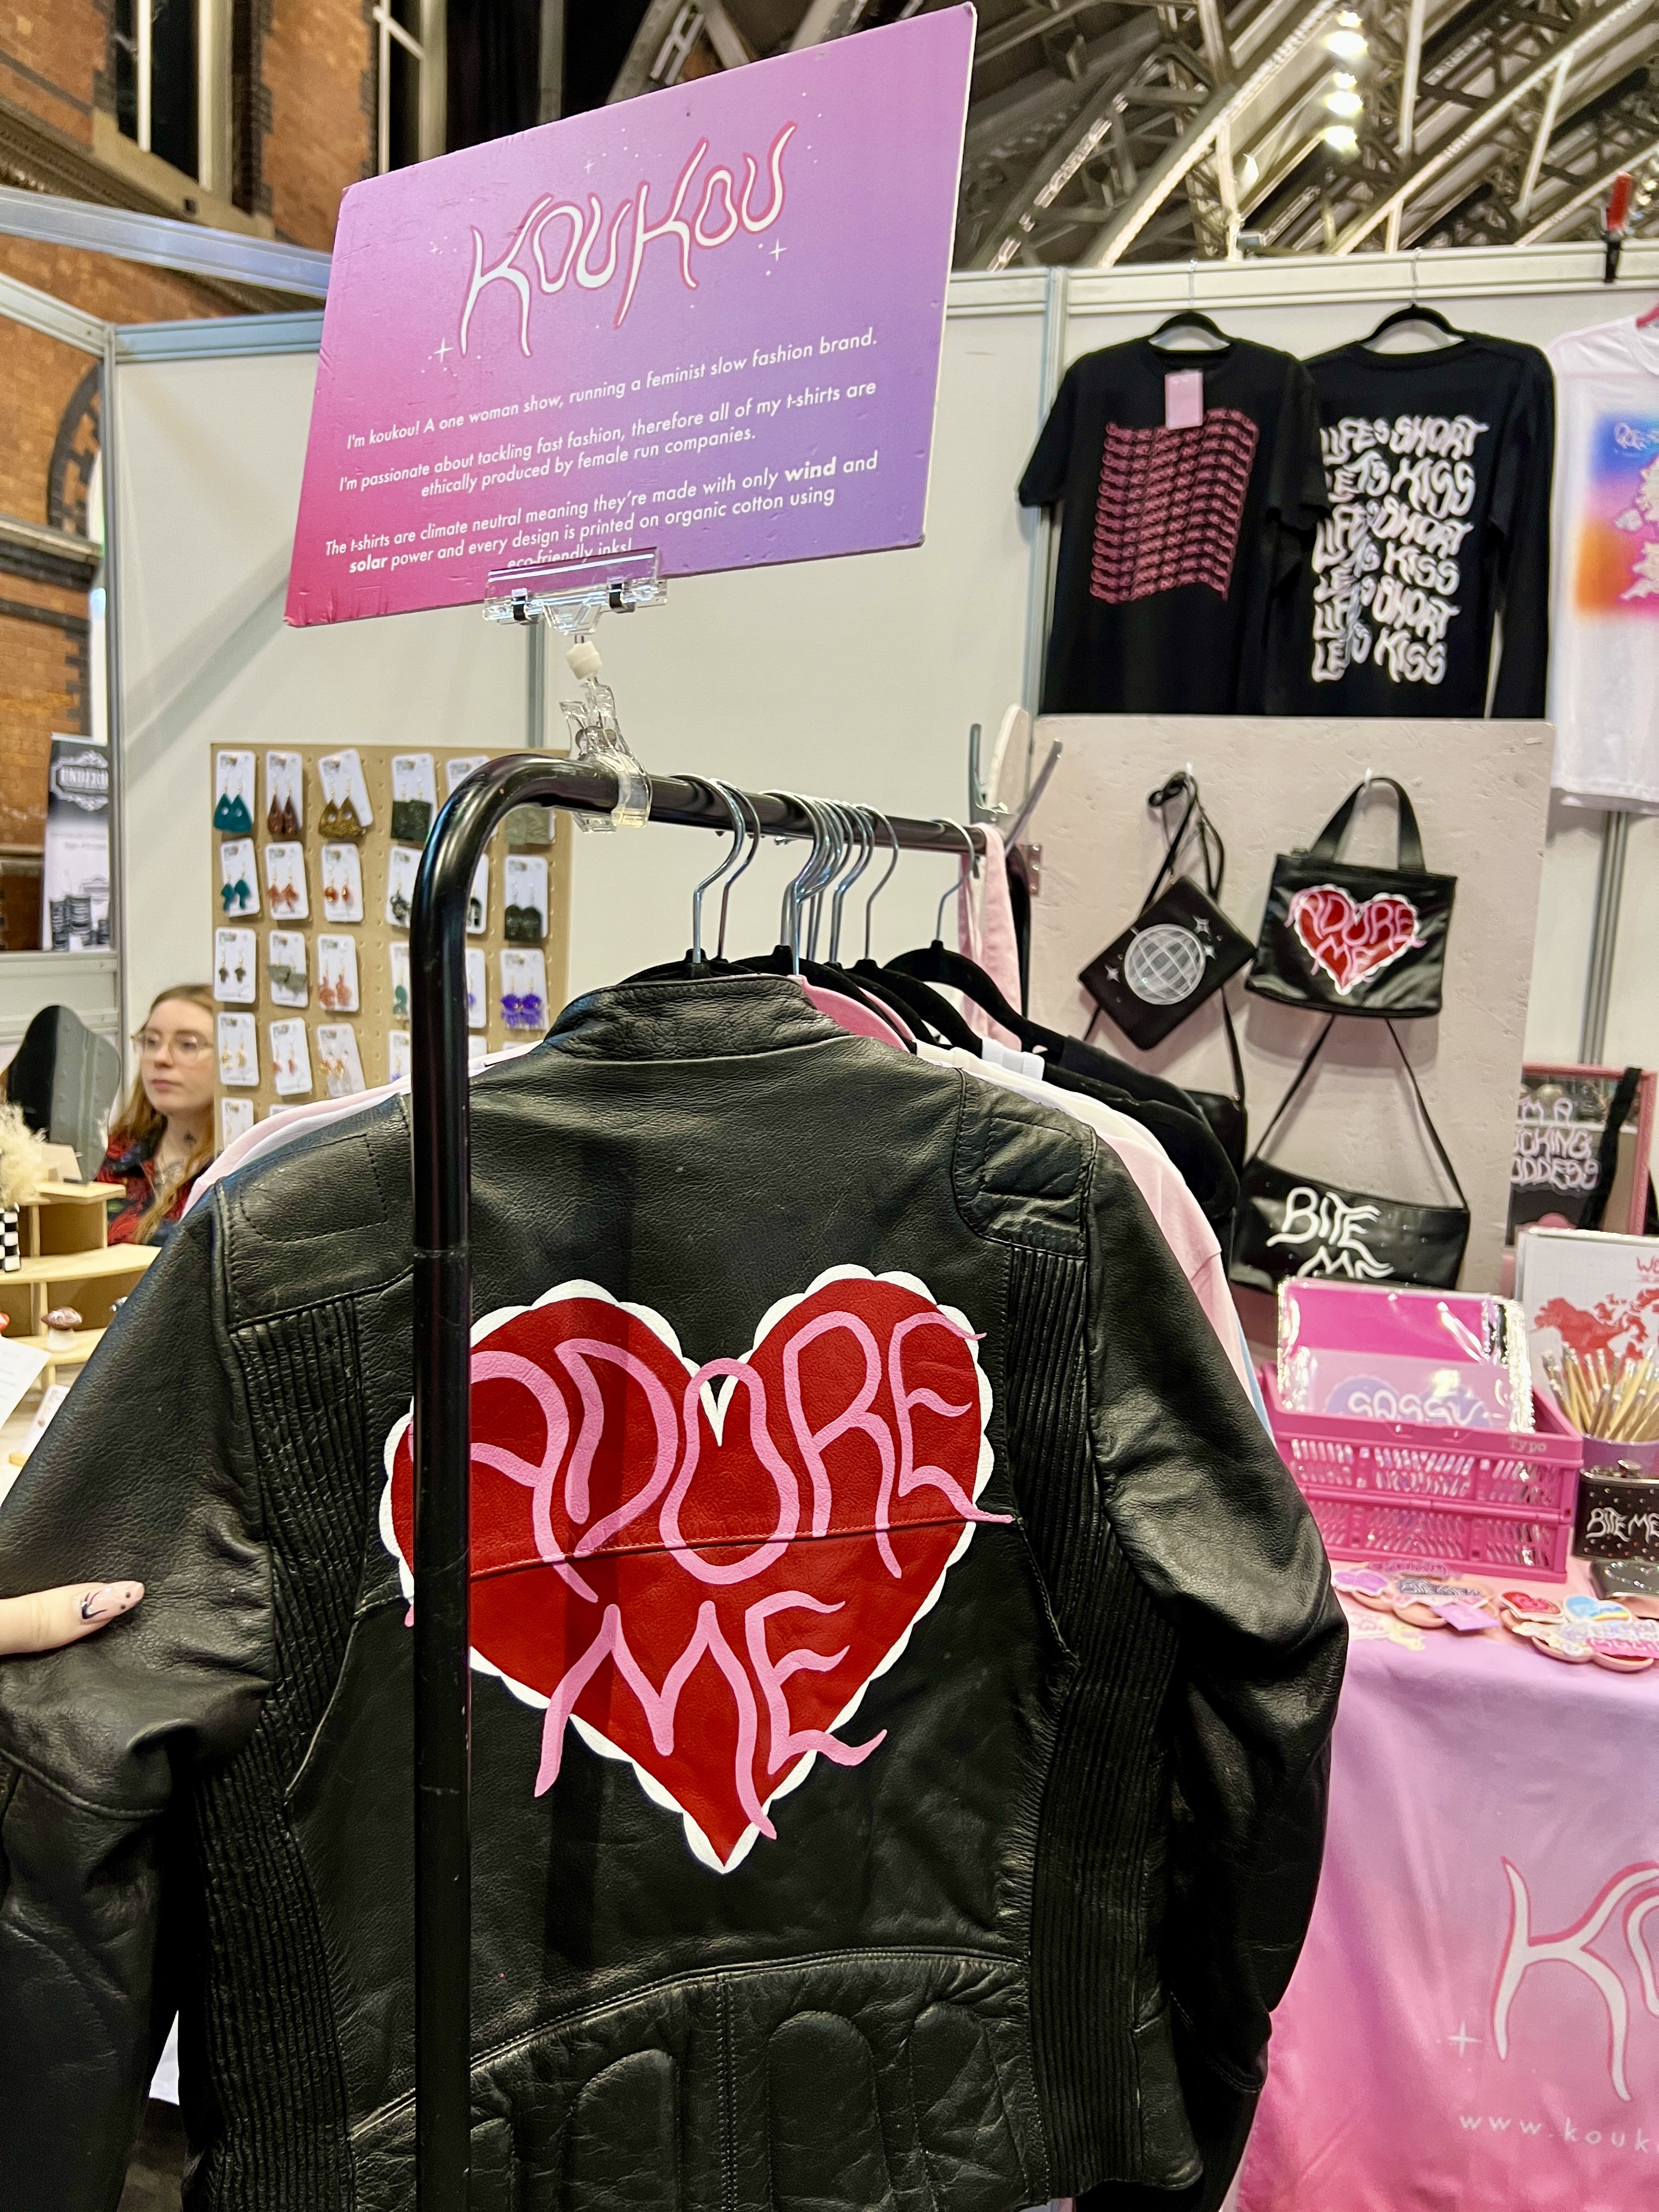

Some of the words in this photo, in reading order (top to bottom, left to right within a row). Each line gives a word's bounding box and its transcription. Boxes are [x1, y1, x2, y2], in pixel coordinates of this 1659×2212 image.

[460, 120, 798, 359] KOUKOU
[369, 420, 420, 445] koukou!
[422, 417, 435, 433] A
[439, 415, 464, 430] one
[469, 404, 519, 424] woman
[523, 394, 564, 413] show,
[569, 381, 626, 403] running
[631, 380, 641, 391] a
[646, 363, 706, 388] feminist
[710, 356, 747, 375] slow
[752, 344, 813, 367] fashion
[819, 326, 877, 354] brand.
[360, 463, 430, 492] passionate
[434, 453, 474, 473] about
[477, 443, 532, 465] tackling
[537, 436, 563, 454] fast
[567, 427, 625, 448] fashion,
[631, 411, 703, 437] therefore
[709, 402, 729, 422] all
[734, 397, 753, 417] of
[757, 399, 782, 417] my
[787, 387, 840, 409] t-shirts
[846, 382, 876, 398] are
[421, 472, 478, 497] ethically
[481, 458, 550, 491] produced
[555, 456, 574, 477] by
[578, 445, 629, 469] female
[633, 445, 659, 459] run
[664, 426, 755, 454] companies.
[1389, 415, 1490, 460] SHORT
[325, 539, 347, 556] The
[350, 534, 390, 552] t-shirts
[393, 532, 416, 544] are
[420, 521, 468, 540] climate
[472, 507, 522, 532] neutral
[526, 501, 589, 523] meaning
[652, 480, 697, 503] made
[702, 472, 736, 494] with
[742, 467, 778, 490] only
[784, 456, 837, 482] wind
[843, 449, 878, 473] and
[1391, 457, 1476, 520] KISS
[349, 554, 388, 573] solar
[390, 550, 435, 572] power
[437, 539, 465, 559] and
[468, 538, 508, 555] every
[512, 528, 559, 548] design
[564, 524, 575, 540] is
[579, 512, 635, 543] printed
[639, 515, 659, 528] on
[664, 501, 727, 527] organic
[732, 496, 783, 515] cotton
[790, 487, 835, 506] using
[1384, 540, 1460, 596] KISS
[1374, 625, 1447, 685] KISS
[1284, 888, 1426, 953] ADORE
[1511, 1156, 1599, 1190] ODDESS
[1266, 1186, 1392, 1268] BITE
[1585, 1506, 1630, 1543] BITE
[534, 1590, 888, 1840] ME
[1459, 2117, 1659, 2154] www.kouk
